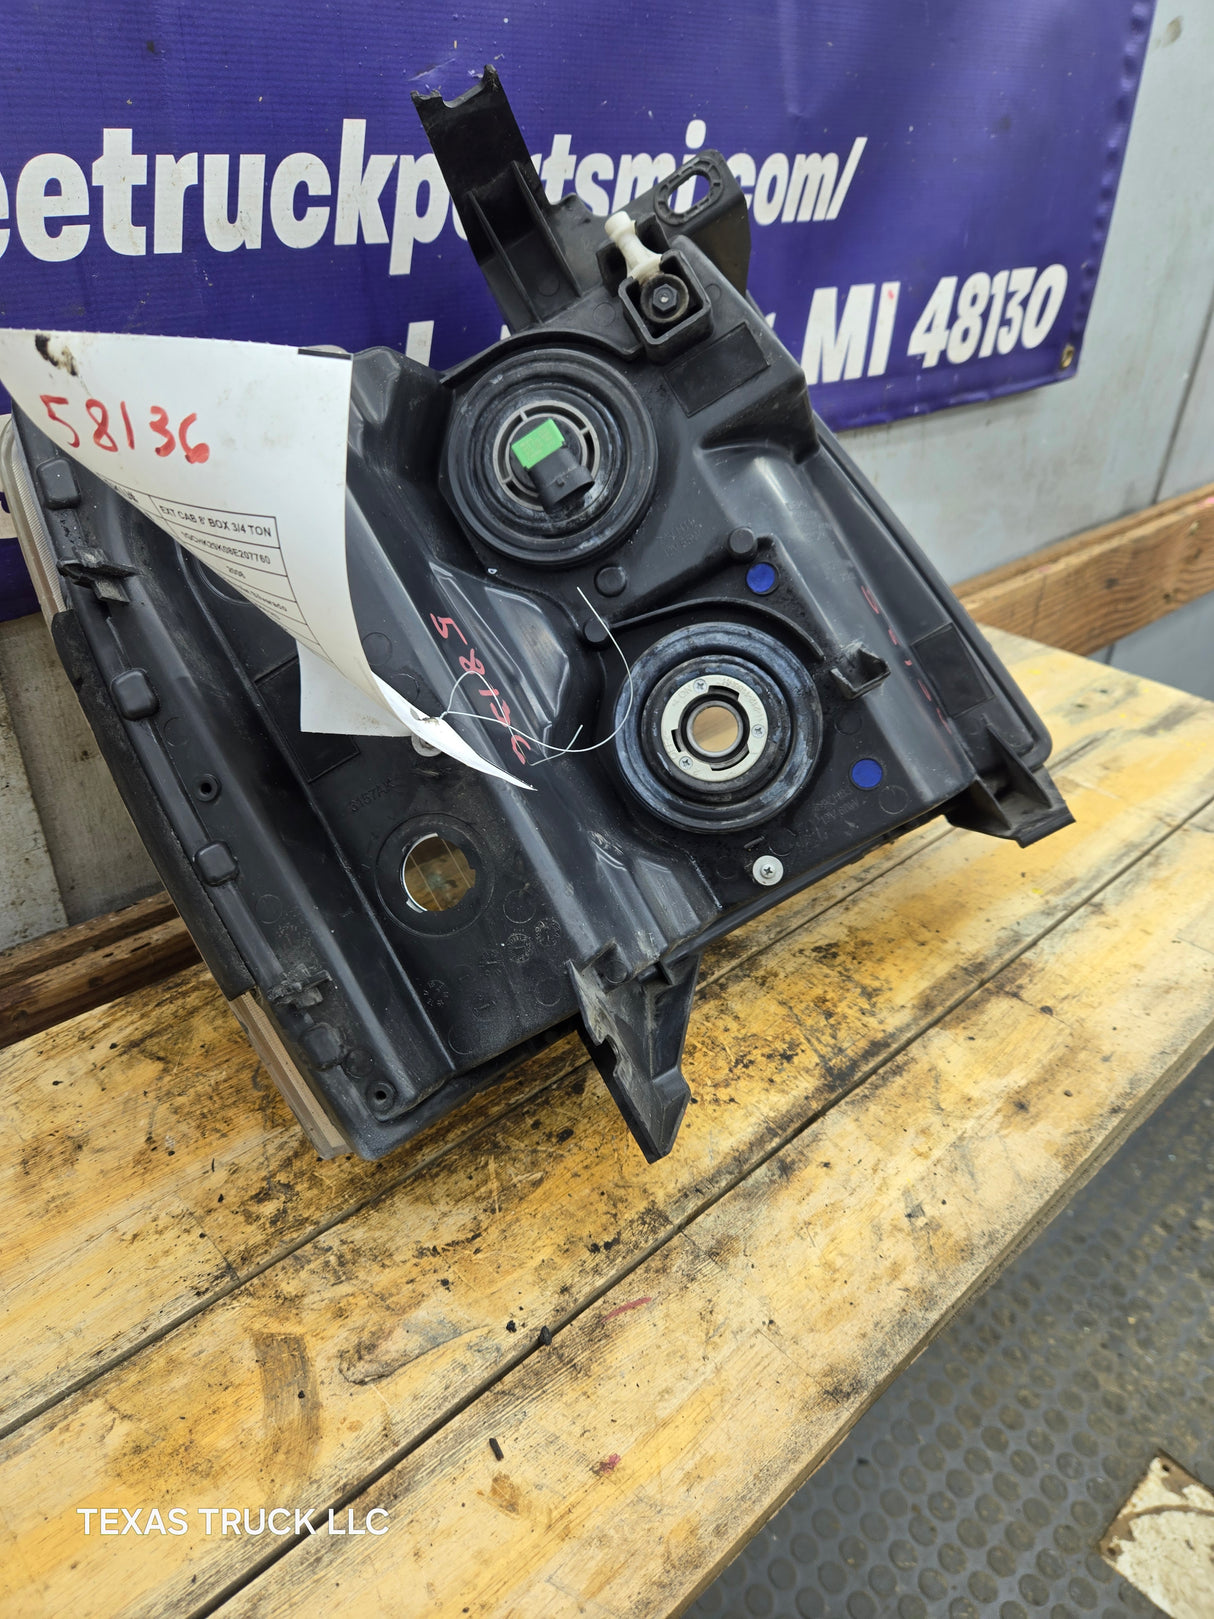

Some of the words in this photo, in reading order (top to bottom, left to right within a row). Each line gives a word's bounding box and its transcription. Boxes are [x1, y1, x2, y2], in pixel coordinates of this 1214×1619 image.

[797, 281, 900, 385] MI
[906, 263, 1069, 369] 48130
[39, 394, 210, 465] 58136
[177, 510, 199, 524] CAB
[207, 517, 231, 532] BOX
[231, 522, 247, 534] 3/4
[247, 524, 273, 538] TON
